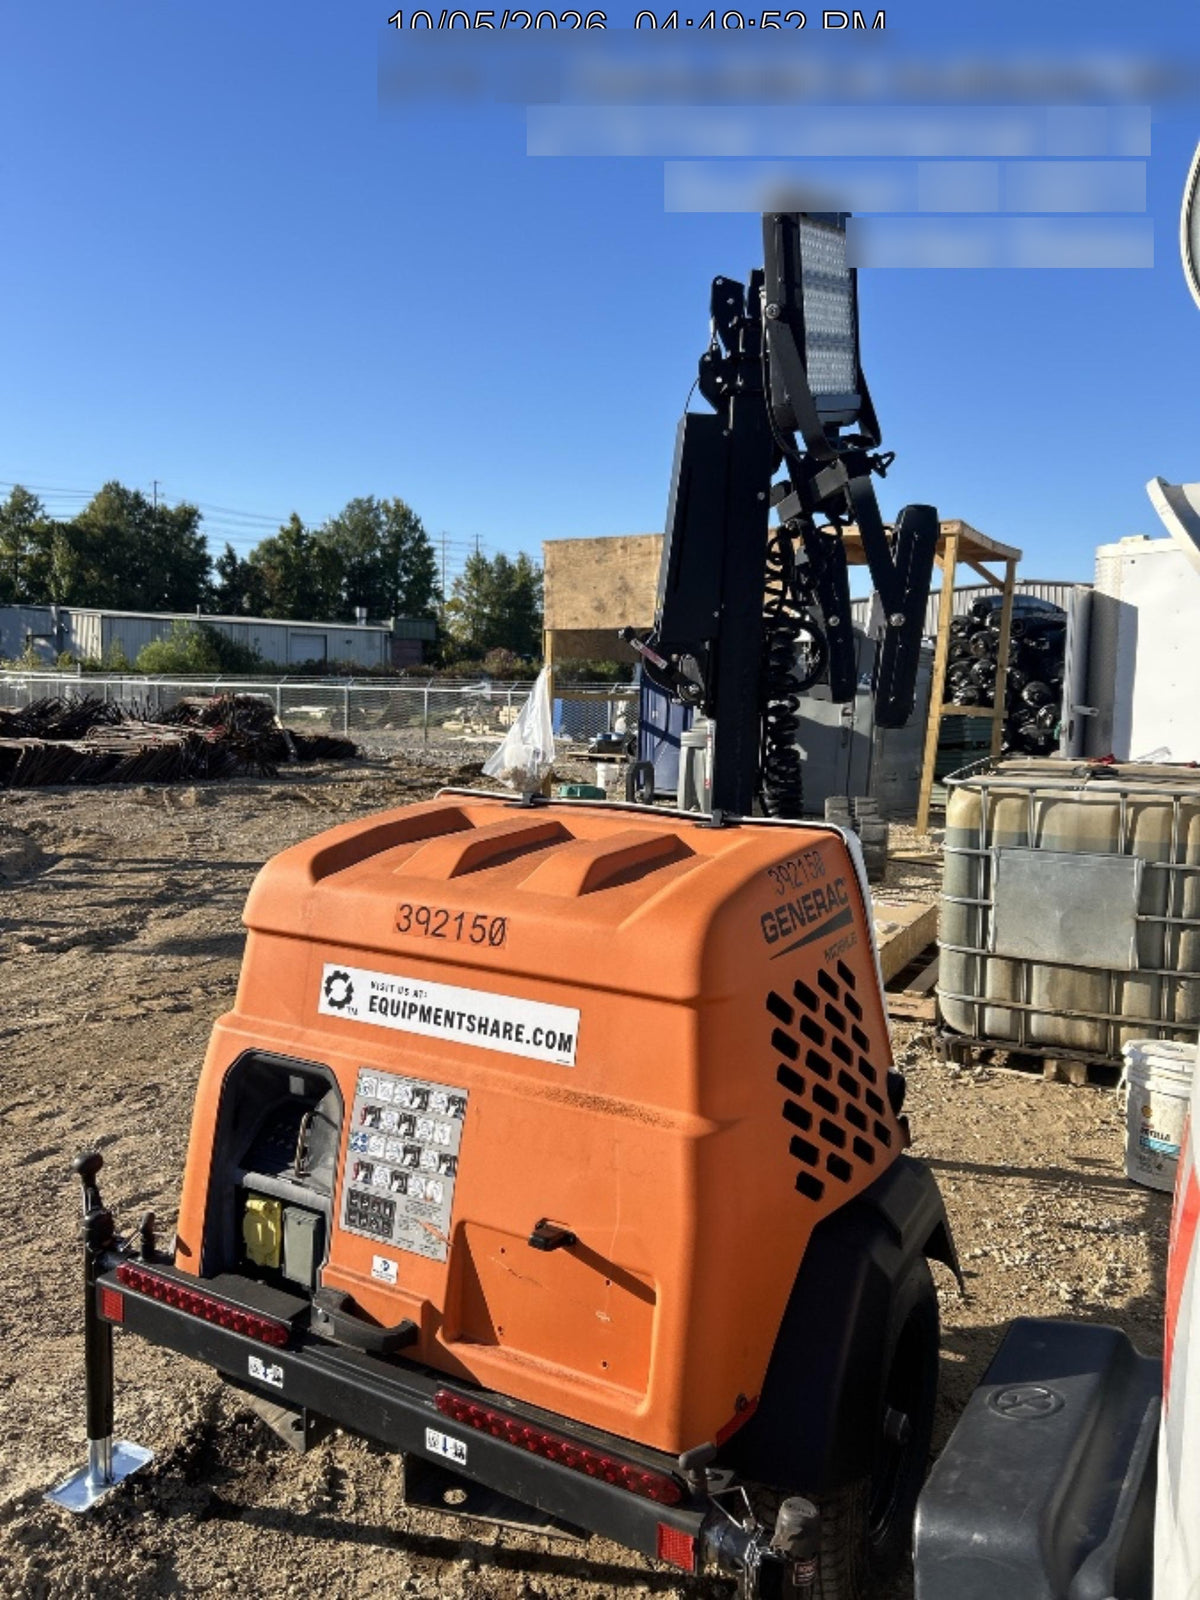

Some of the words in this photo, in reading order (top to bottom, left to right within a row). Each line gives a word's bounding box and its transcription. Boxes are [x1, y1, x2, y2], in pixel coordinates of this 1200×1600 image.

[396, 904, 507, 946] 392150
[760, 877, 848, 944] GENERAC
[371, 980, 395, 993] VISIT
[397, 986, 410, 997] US
[368, 995, 573, 1054] EQUIPMENTSHARE.COM
